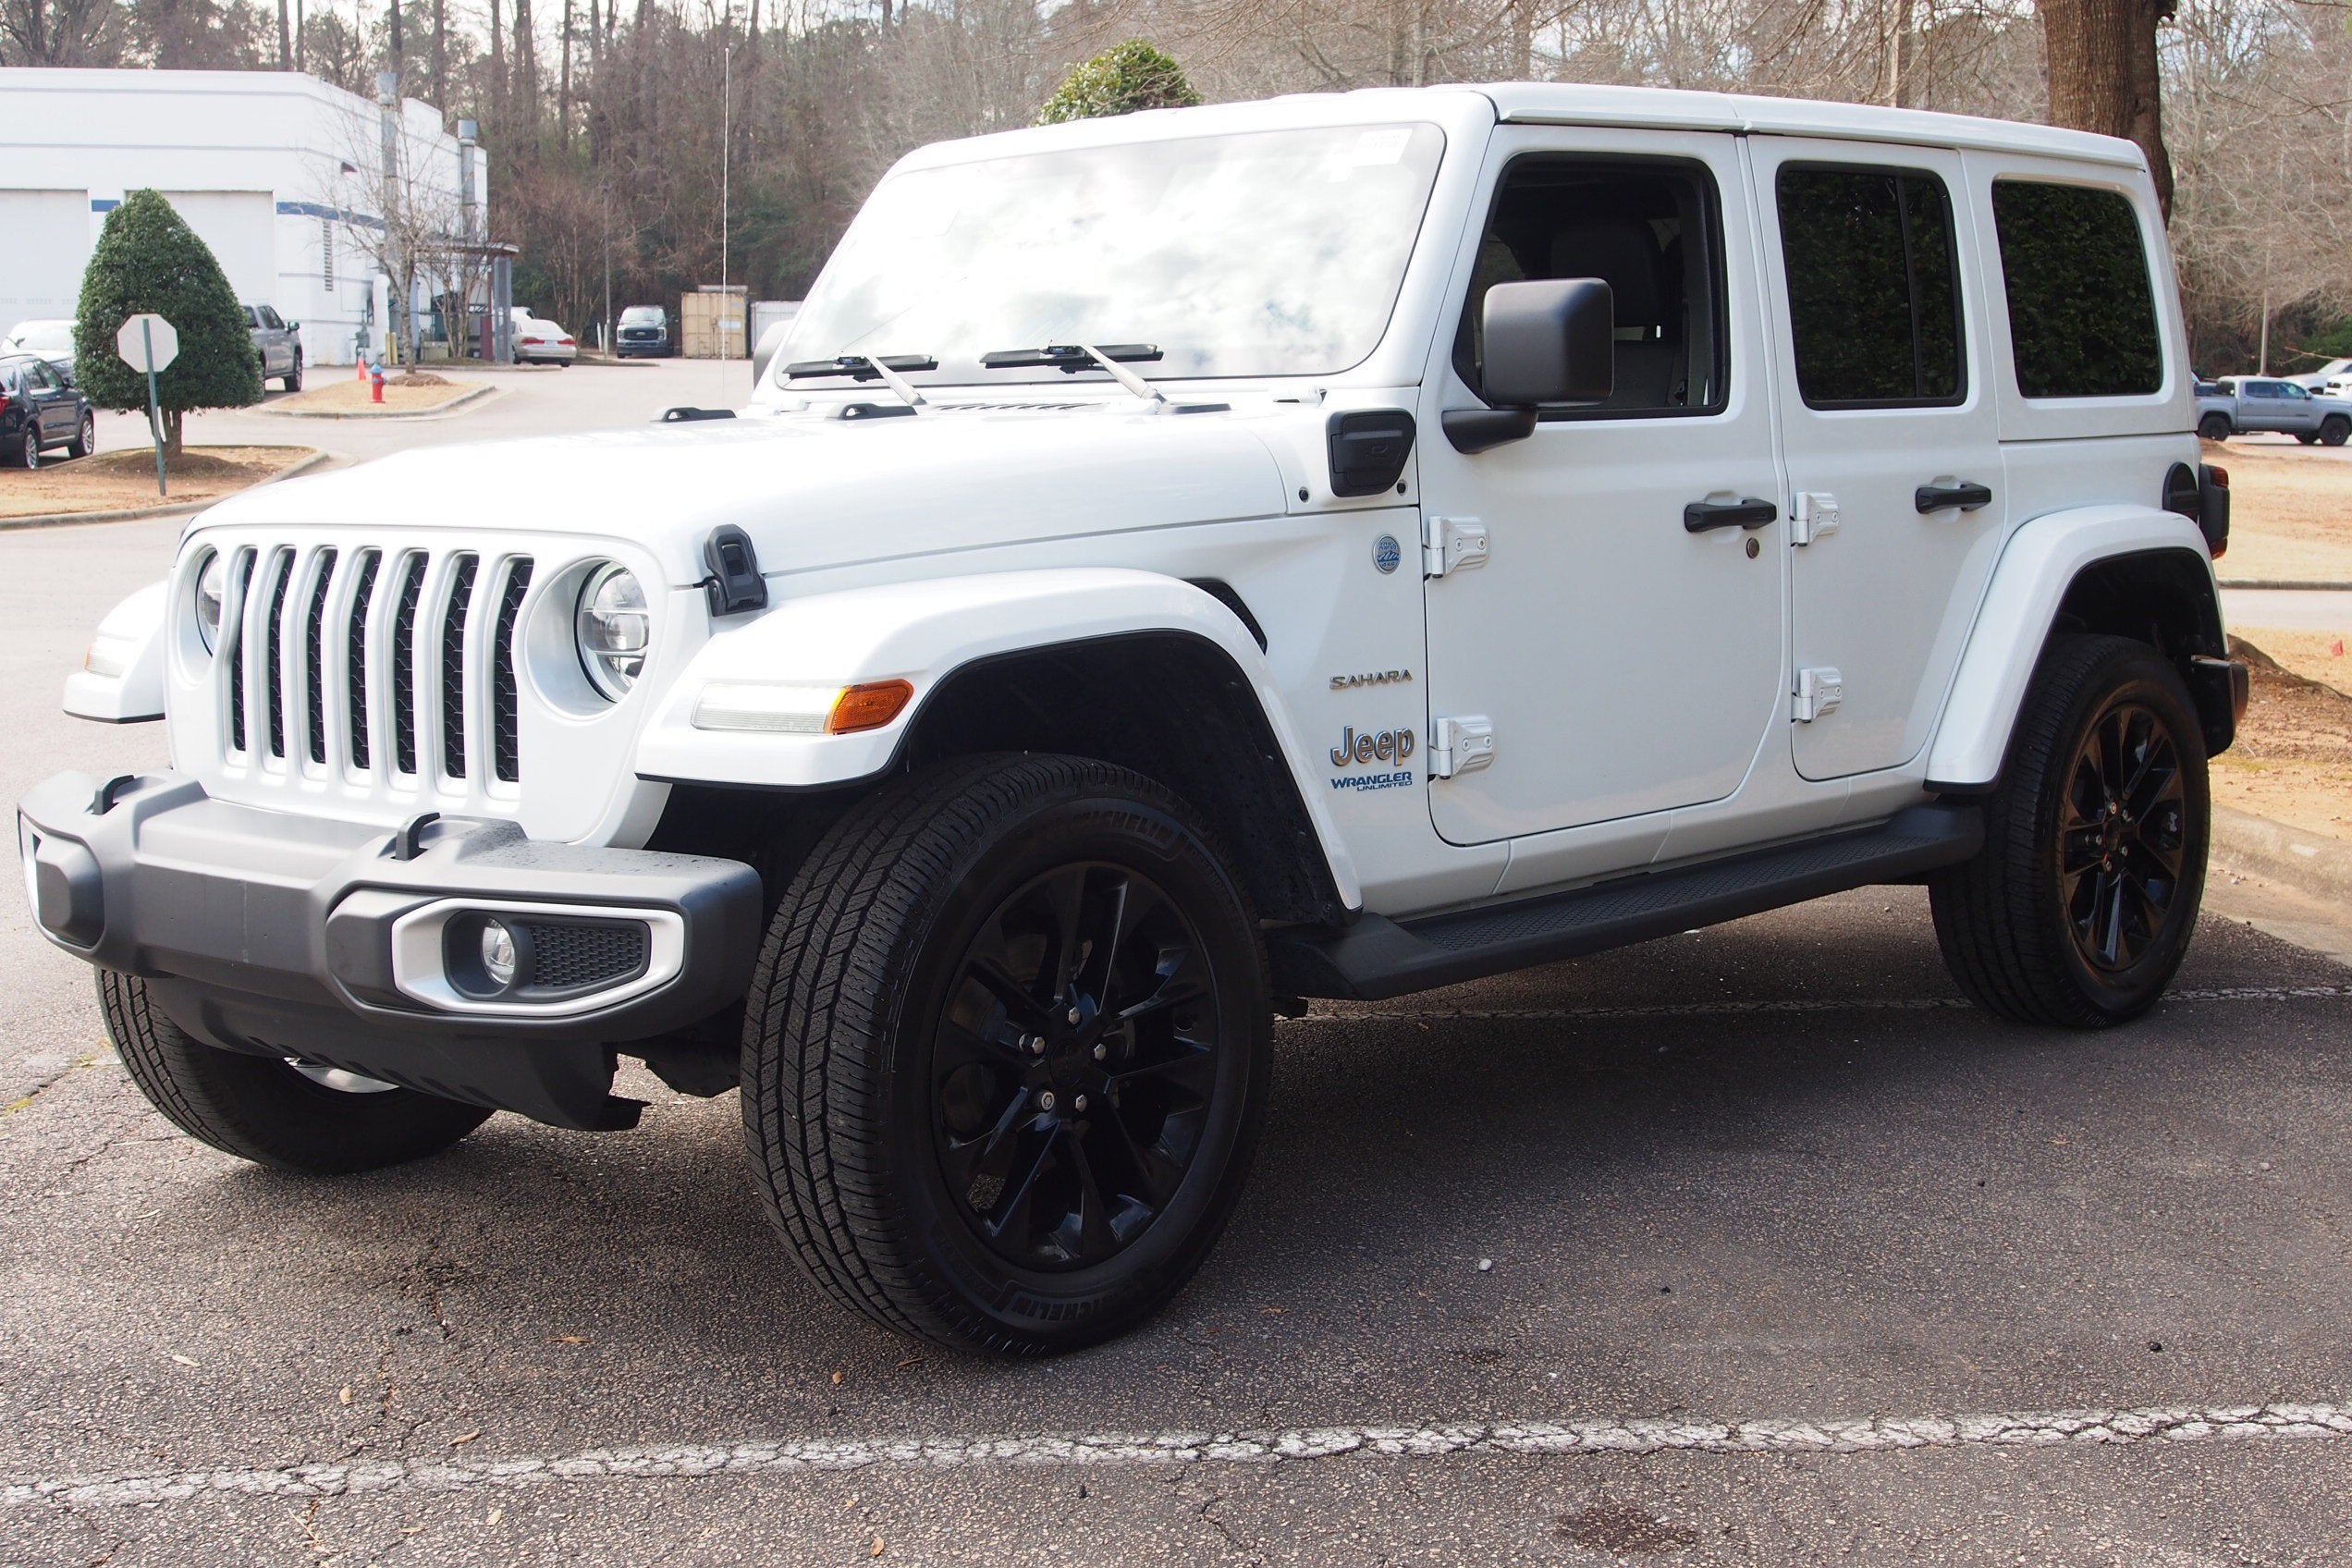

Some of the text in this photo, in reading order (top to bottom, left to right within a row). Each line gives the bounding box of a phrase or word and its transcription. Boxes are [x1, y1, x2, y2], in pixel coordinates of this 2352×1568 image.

[1329, 668, 1413, 691] SAHARA
[1330, 725, 1415, 766] Jeep
[1330, 771, 1413, 790] WRANGLER
[1356, 781, 1413, 791] UNLIMITED
[1073, 810, 1174, 845] MICHELIN
